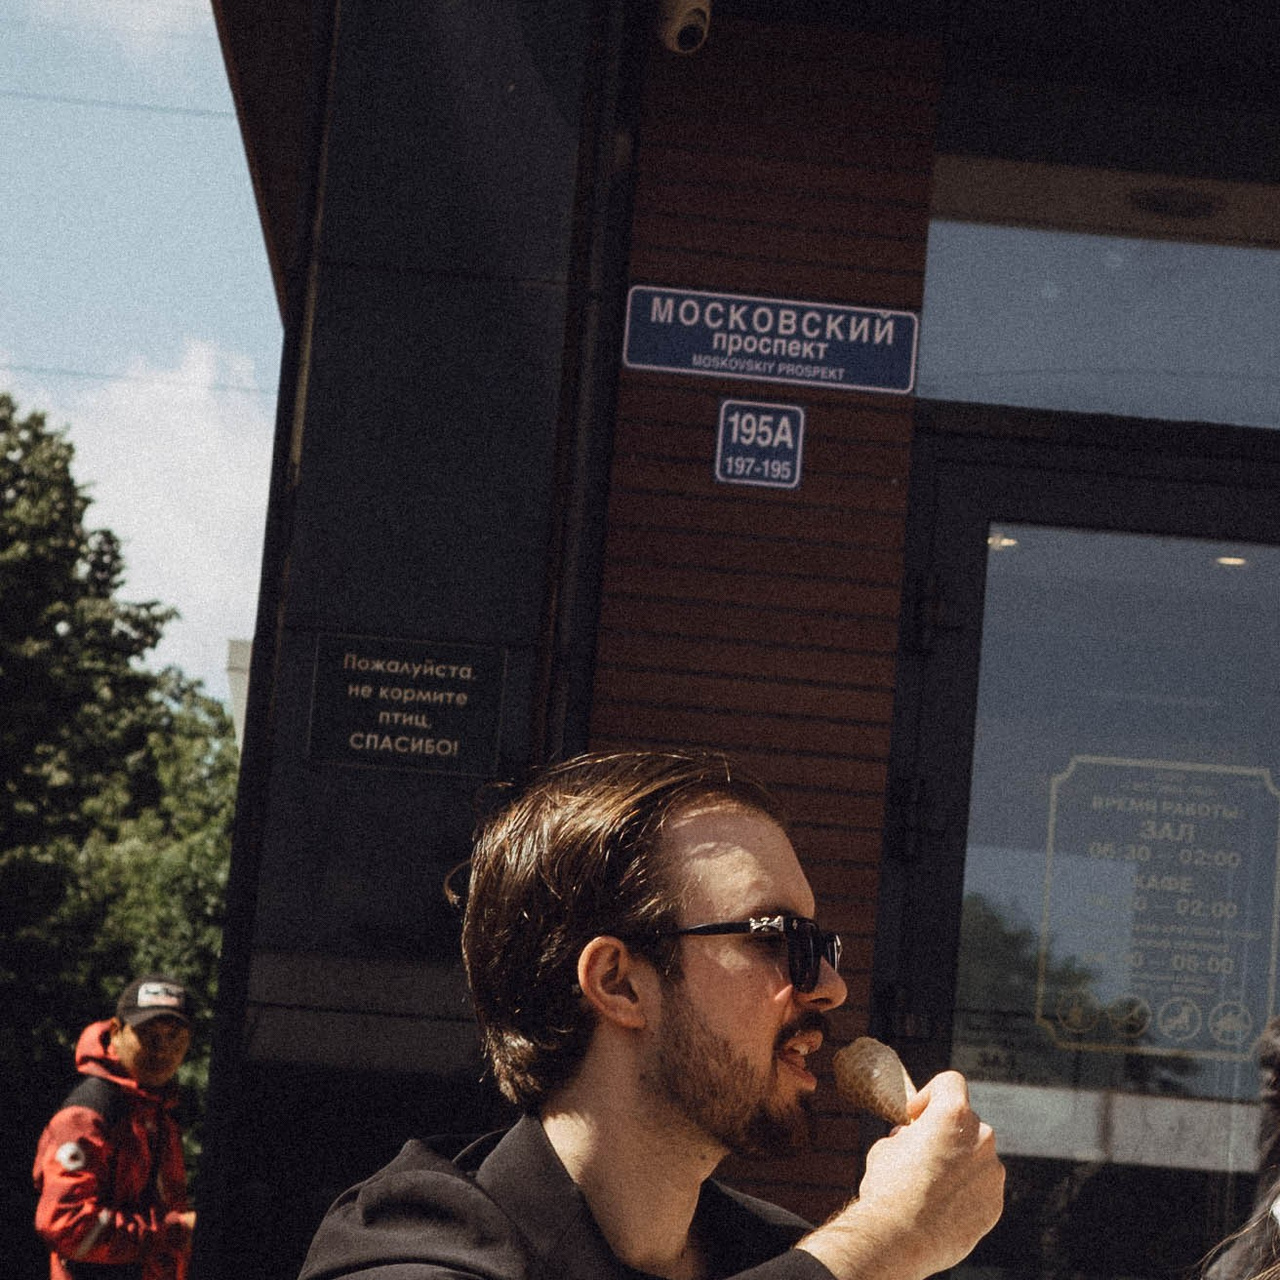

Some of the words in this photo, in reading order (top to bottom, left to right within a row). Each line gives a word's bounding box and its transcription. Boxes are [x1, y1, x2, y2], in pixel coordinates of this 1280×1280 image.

[650, 296, 895, 345] МОСКОВСКИЙ
[712, 331, 829, 360] проспект
[777, 363, 846, 381] PROSPEKT
[727, 412, 794, 449] 195А
[725, 456, 791, 480] 197-195
[348, 684, 373, 699] не
[379, 686, 468, 706] кормите
[349, 732, 459, 757] СПАСИБО!
[1138, 821, 1196, 842] ЗАЛ
